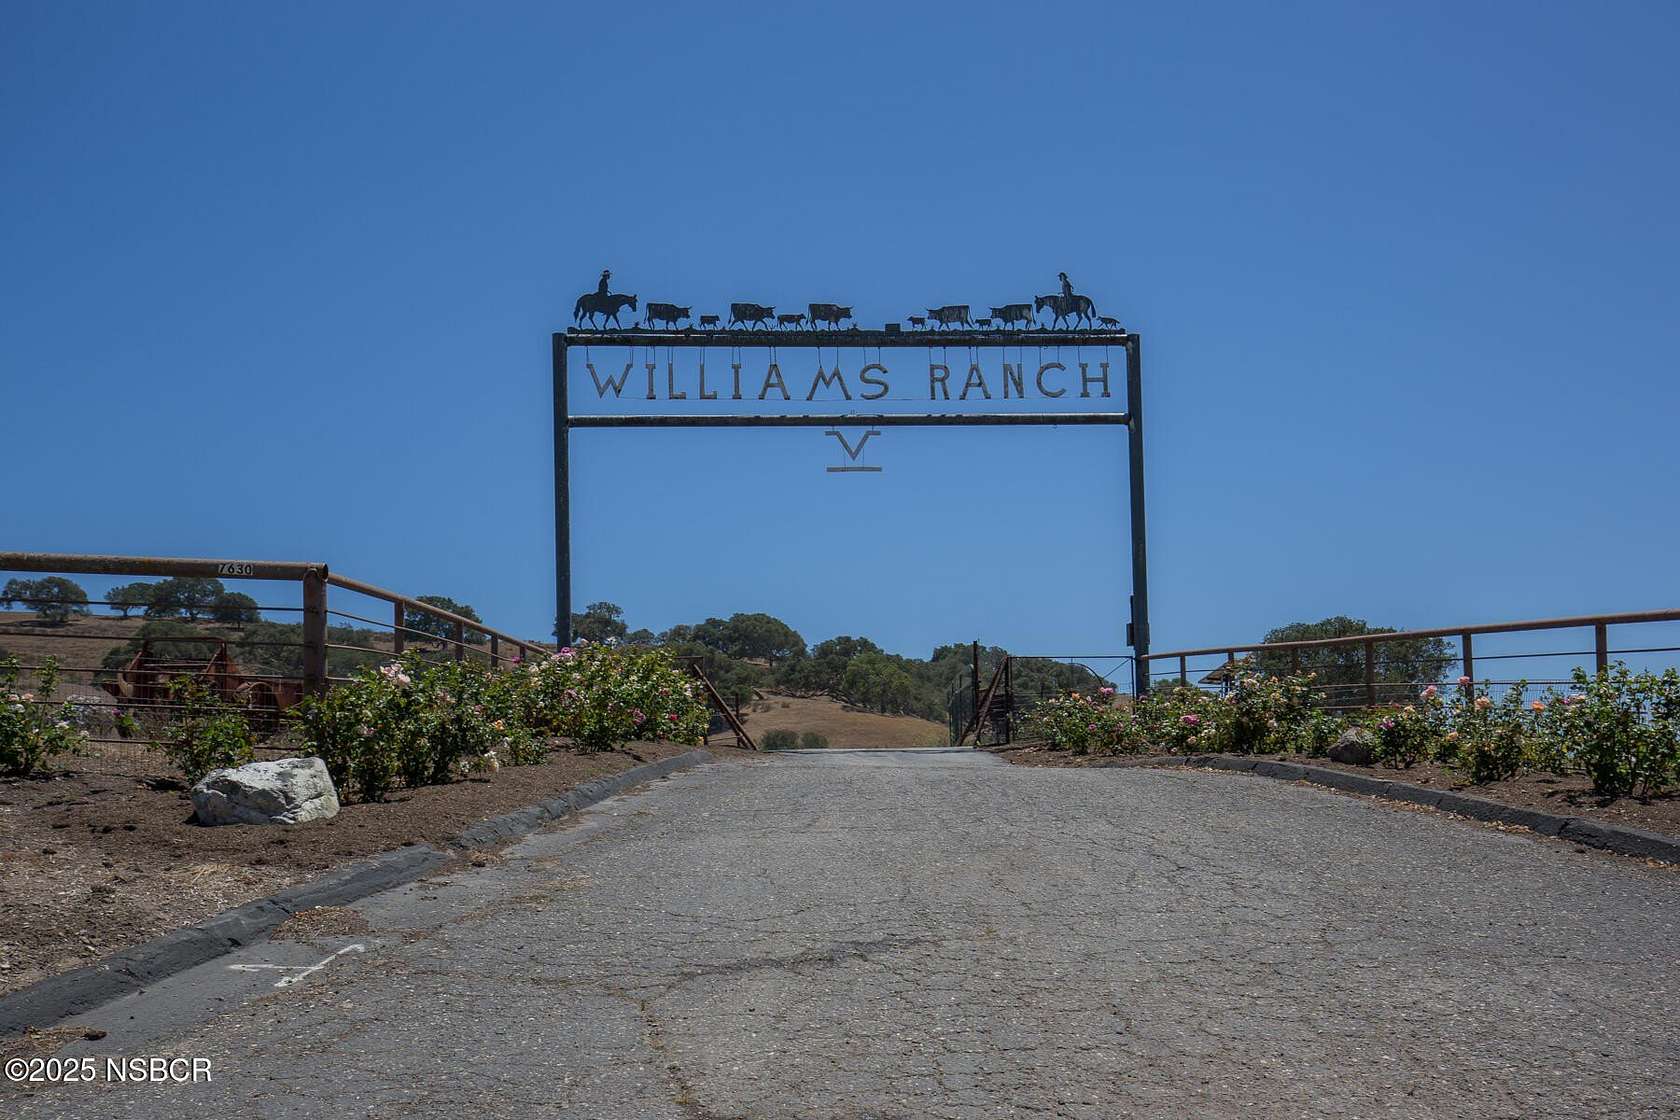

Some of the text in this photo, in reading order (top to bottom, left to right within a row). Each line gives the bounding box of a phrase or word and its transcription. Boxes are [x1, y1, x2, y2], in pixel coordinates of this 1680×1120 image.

[586, 362, 1111, 401] WILLIAMS RANCH
[218, 563, 254, 577] 7630
